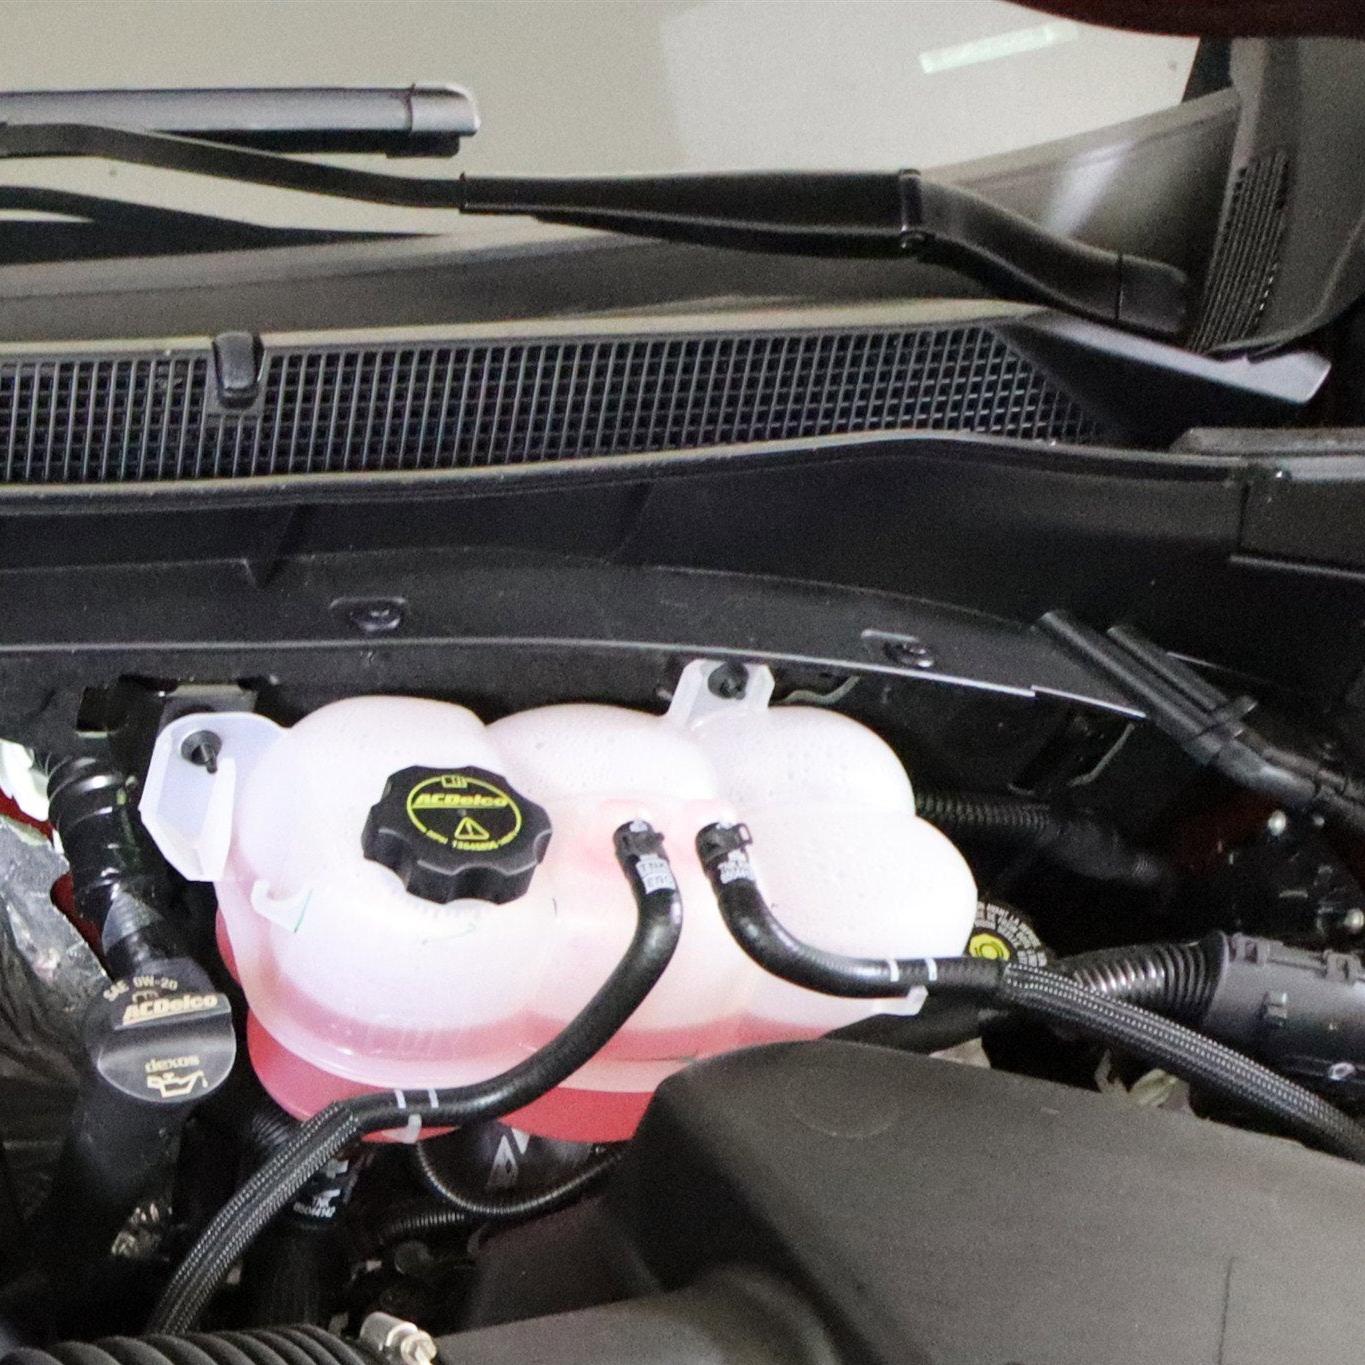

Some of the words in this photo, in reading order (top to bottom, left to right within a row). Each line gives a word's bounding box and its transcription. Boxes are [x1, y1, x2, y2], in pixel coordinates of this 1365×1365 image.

[413, 793, 509, 808] ACDelco
[103, 980, 130, 1002] SAE
[133, 975, 178, 991] 0W-20
[122, 994, 218, 1025] ACDelco
[145, 1055, 200, 1072] dexos
